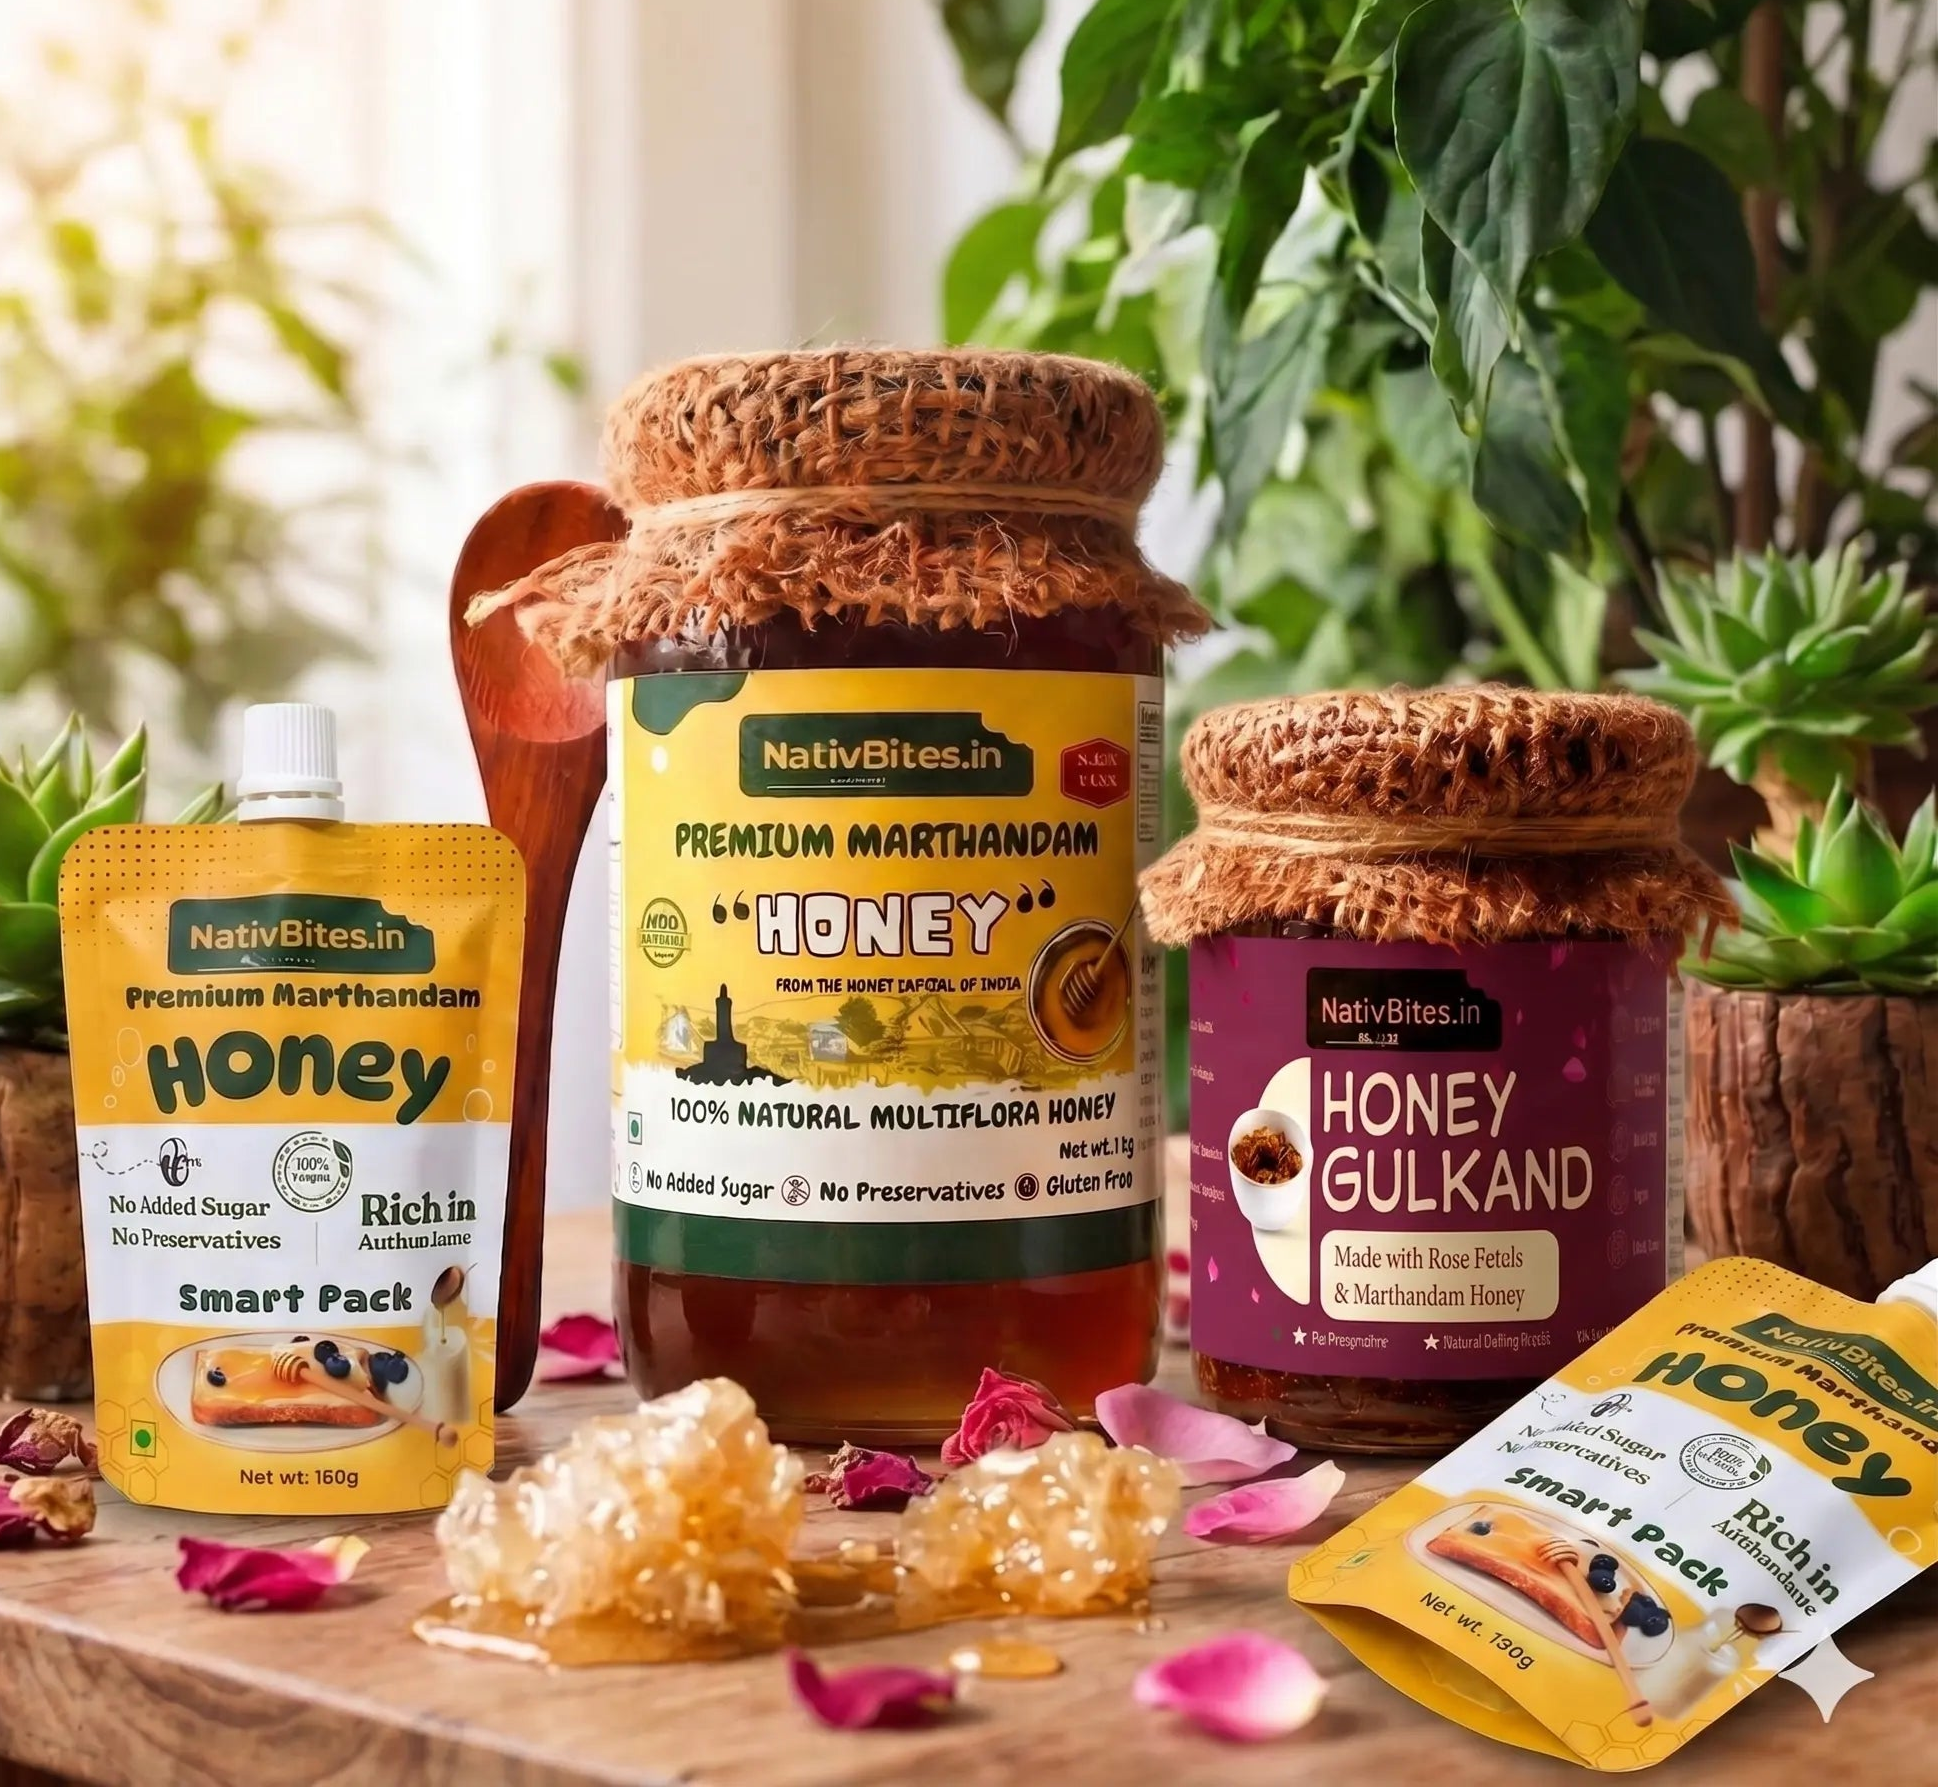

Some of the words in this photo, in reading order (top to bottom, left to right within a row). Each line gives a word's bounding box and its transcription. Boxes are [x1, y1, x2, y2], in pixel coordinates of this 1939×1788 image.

[763, 738, 1002, 770] NativBites.in
[675, 822, 835, 859] PREMIUM
[848, 821, 1099, 858] MARTHANDAM
[190, 919, 405, 950] NativBites.in
[126, 985, 264, 1009] Premium
[272, 982, 481, 1008] Marthandam
[776, 978, 813, 993] FROM
[817, 978, 842, 993] THE
[960, 978, 977, 992] OF
[980, 976, 1021, 991] INDIA
[1322, 997, 1480, 1025] NativBites.in
[147, 1030, 451, 1126] Honey
[670, 1097, 729, 1125] 100%
[737, 1101, 860, 1130] NATURAL
[870, 1101, 1040, 1130] MULTIFLORA
[1048, 1092, 1117, 1125] HONEY
[1322, 1070, 1517, 1138] HONEY
[1059, 1140, 1088, 1159] Net
[646, 1169, 662, 1190] No
[666, 1173, 716, 1196] Added
[720, 1177, 775, 1205] Sugar
[819, 1180, 850, 1202] No
[856, 1180, 1006, 1203] Preservatives
[1046, 1172, 1101, 1196] Gluten
[1321, 1145, 1594, 1214] GULKAND
[109, 1194, 137, 1215] No
[140, 1194, 198, 1216] Added
[201, 1196, 271, 1220] Sugar
[361, 1190, 443, 1226] Rich
[447, 1189, 477, 1222] in
[112, 1227, 140, 1247] No
[142, 1228, 282, 1250] Preservatives
[1334, 1245, 1382, 1269] Made
[1386, 1245, 1424, 1270] with
[1428, 1247, 1470, 1269] Rose
[179, 1283, 304, 1313] Smart
[318, 1281, 413, 1312] Pack
[1334, 1283, 1350, 1305] &
[1353, 1283, 1464, 1308] Marthandam
[1469, 1284, 1526, 1312] Honey
[1632, 1351, 1912, 1497] Honey
[1599, 1427, 1667, 1462] Sugar
[240, 1469, 273, 1486] Net
[279, 1471, 310, 1486] wt:
[1631, 1523, 1731, 1599] Pack
[1732, 1497, 1811, 1572] Rich
[1806, 1563, 1840, 1605] in
[1419, 1591, 1456, 1617] Net
[1456, 1613, 1483, 1640] wt.
[1488, 1630, 1536, 1671] 130g
